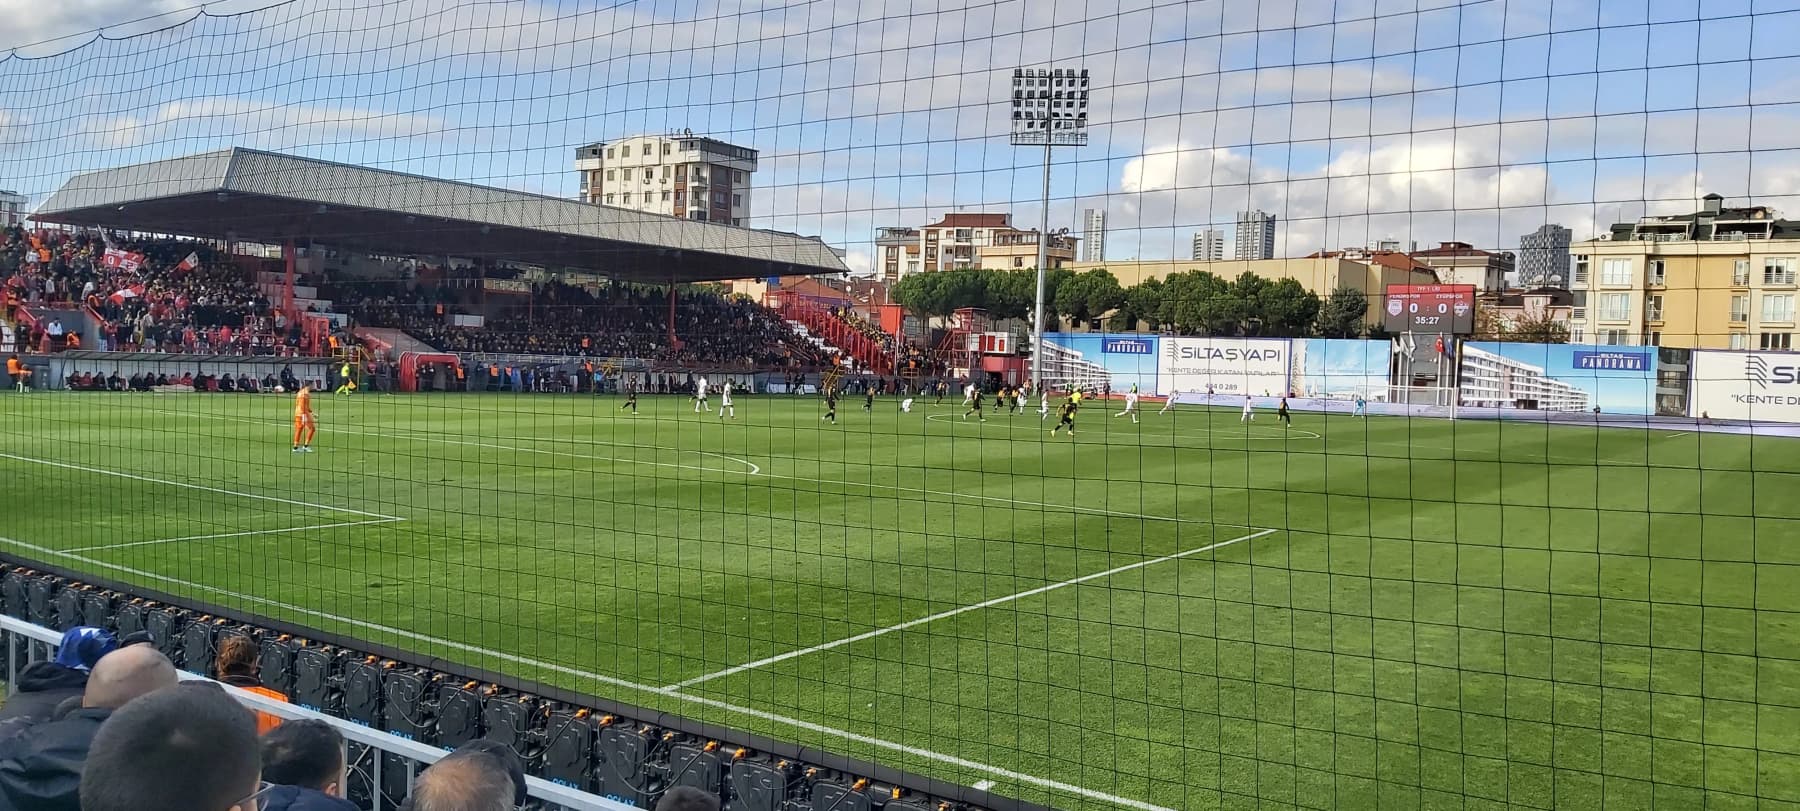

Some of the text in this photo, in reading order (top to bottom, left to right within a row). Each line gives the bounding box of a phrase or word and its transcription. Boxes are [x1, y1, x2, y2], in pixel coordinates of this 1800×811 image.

[1409, 303, 1447, 313] 0 0
[1415, 316, 1440, 324] 35:27
[1582, 359, 1641, 369] PANORAMA
[1732, 394, 1783, 404] "KENTE
